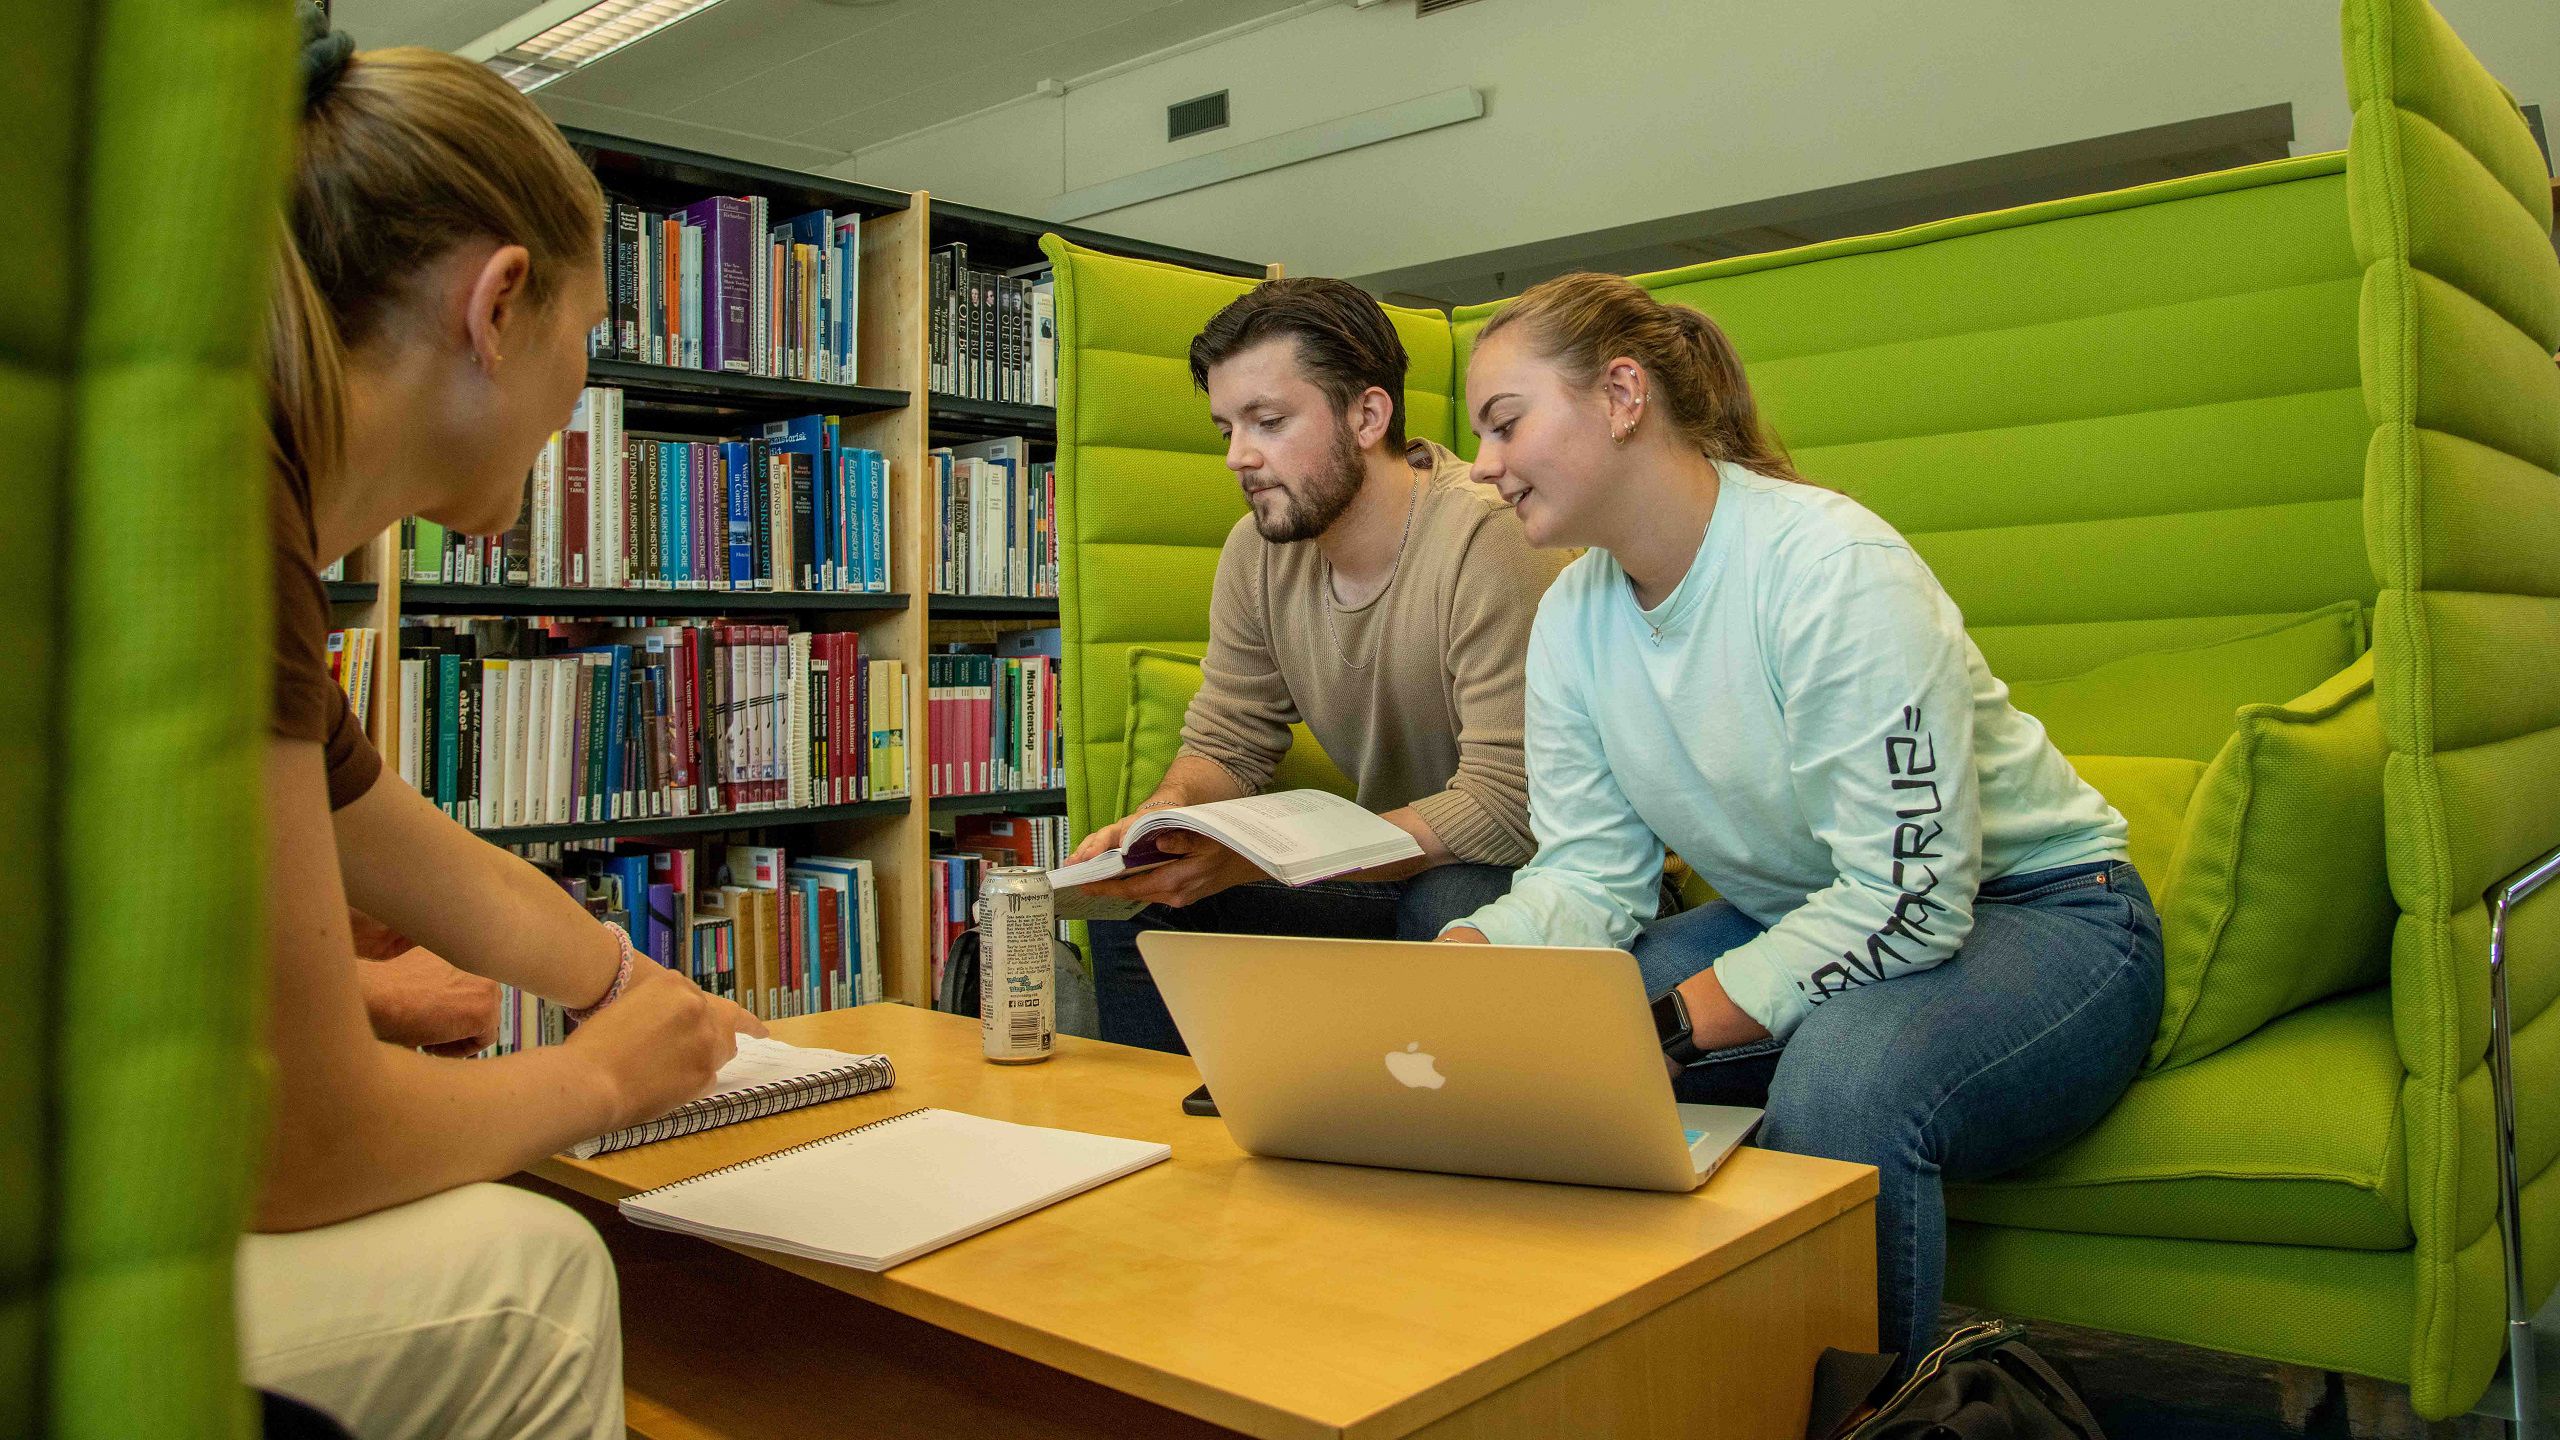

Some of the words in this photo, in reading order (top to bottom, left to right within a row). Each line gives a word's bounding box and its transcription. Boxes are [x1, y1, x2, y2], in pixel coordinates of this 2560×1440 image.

[958, 304, 967, 333] OLE
[971, 310, 979, 335] OLE
[985, 312, 994, 337] OLE
[1001, 314, 1009, 339] OLE
[1012, 316, 1021, 340] OLE
[958, 337, 967, 354] BU
[985, 340, 994, 357] BU
[1001, 343, 1009, 368] BUL
[1012, 344, 1021, 369] BUL
[629, 444, 638, 499] GYLDENDALS
[649, 444, 657, 500] GYLDENDALS
[660, 447, 668, 501] GYLDENDALS
[758, 445, 767, 478] GADS
[735, 474, 741, 482] in
[849, 459, 857, 498] Europas
[871, 460, 880, 499] Europas
[629, 502, 638, 566] MUSIKHISTORIE
[649, 502, 657, 566] MUSIKHISTORIE
[660, 504, 668, 567] MUSIKHISTORIE
[1025, 670, 1036, 751] Musikvetenskap
[615, 715, 624, 745] MUSIK
[687, 710, 695, 763] musikkhistorie
